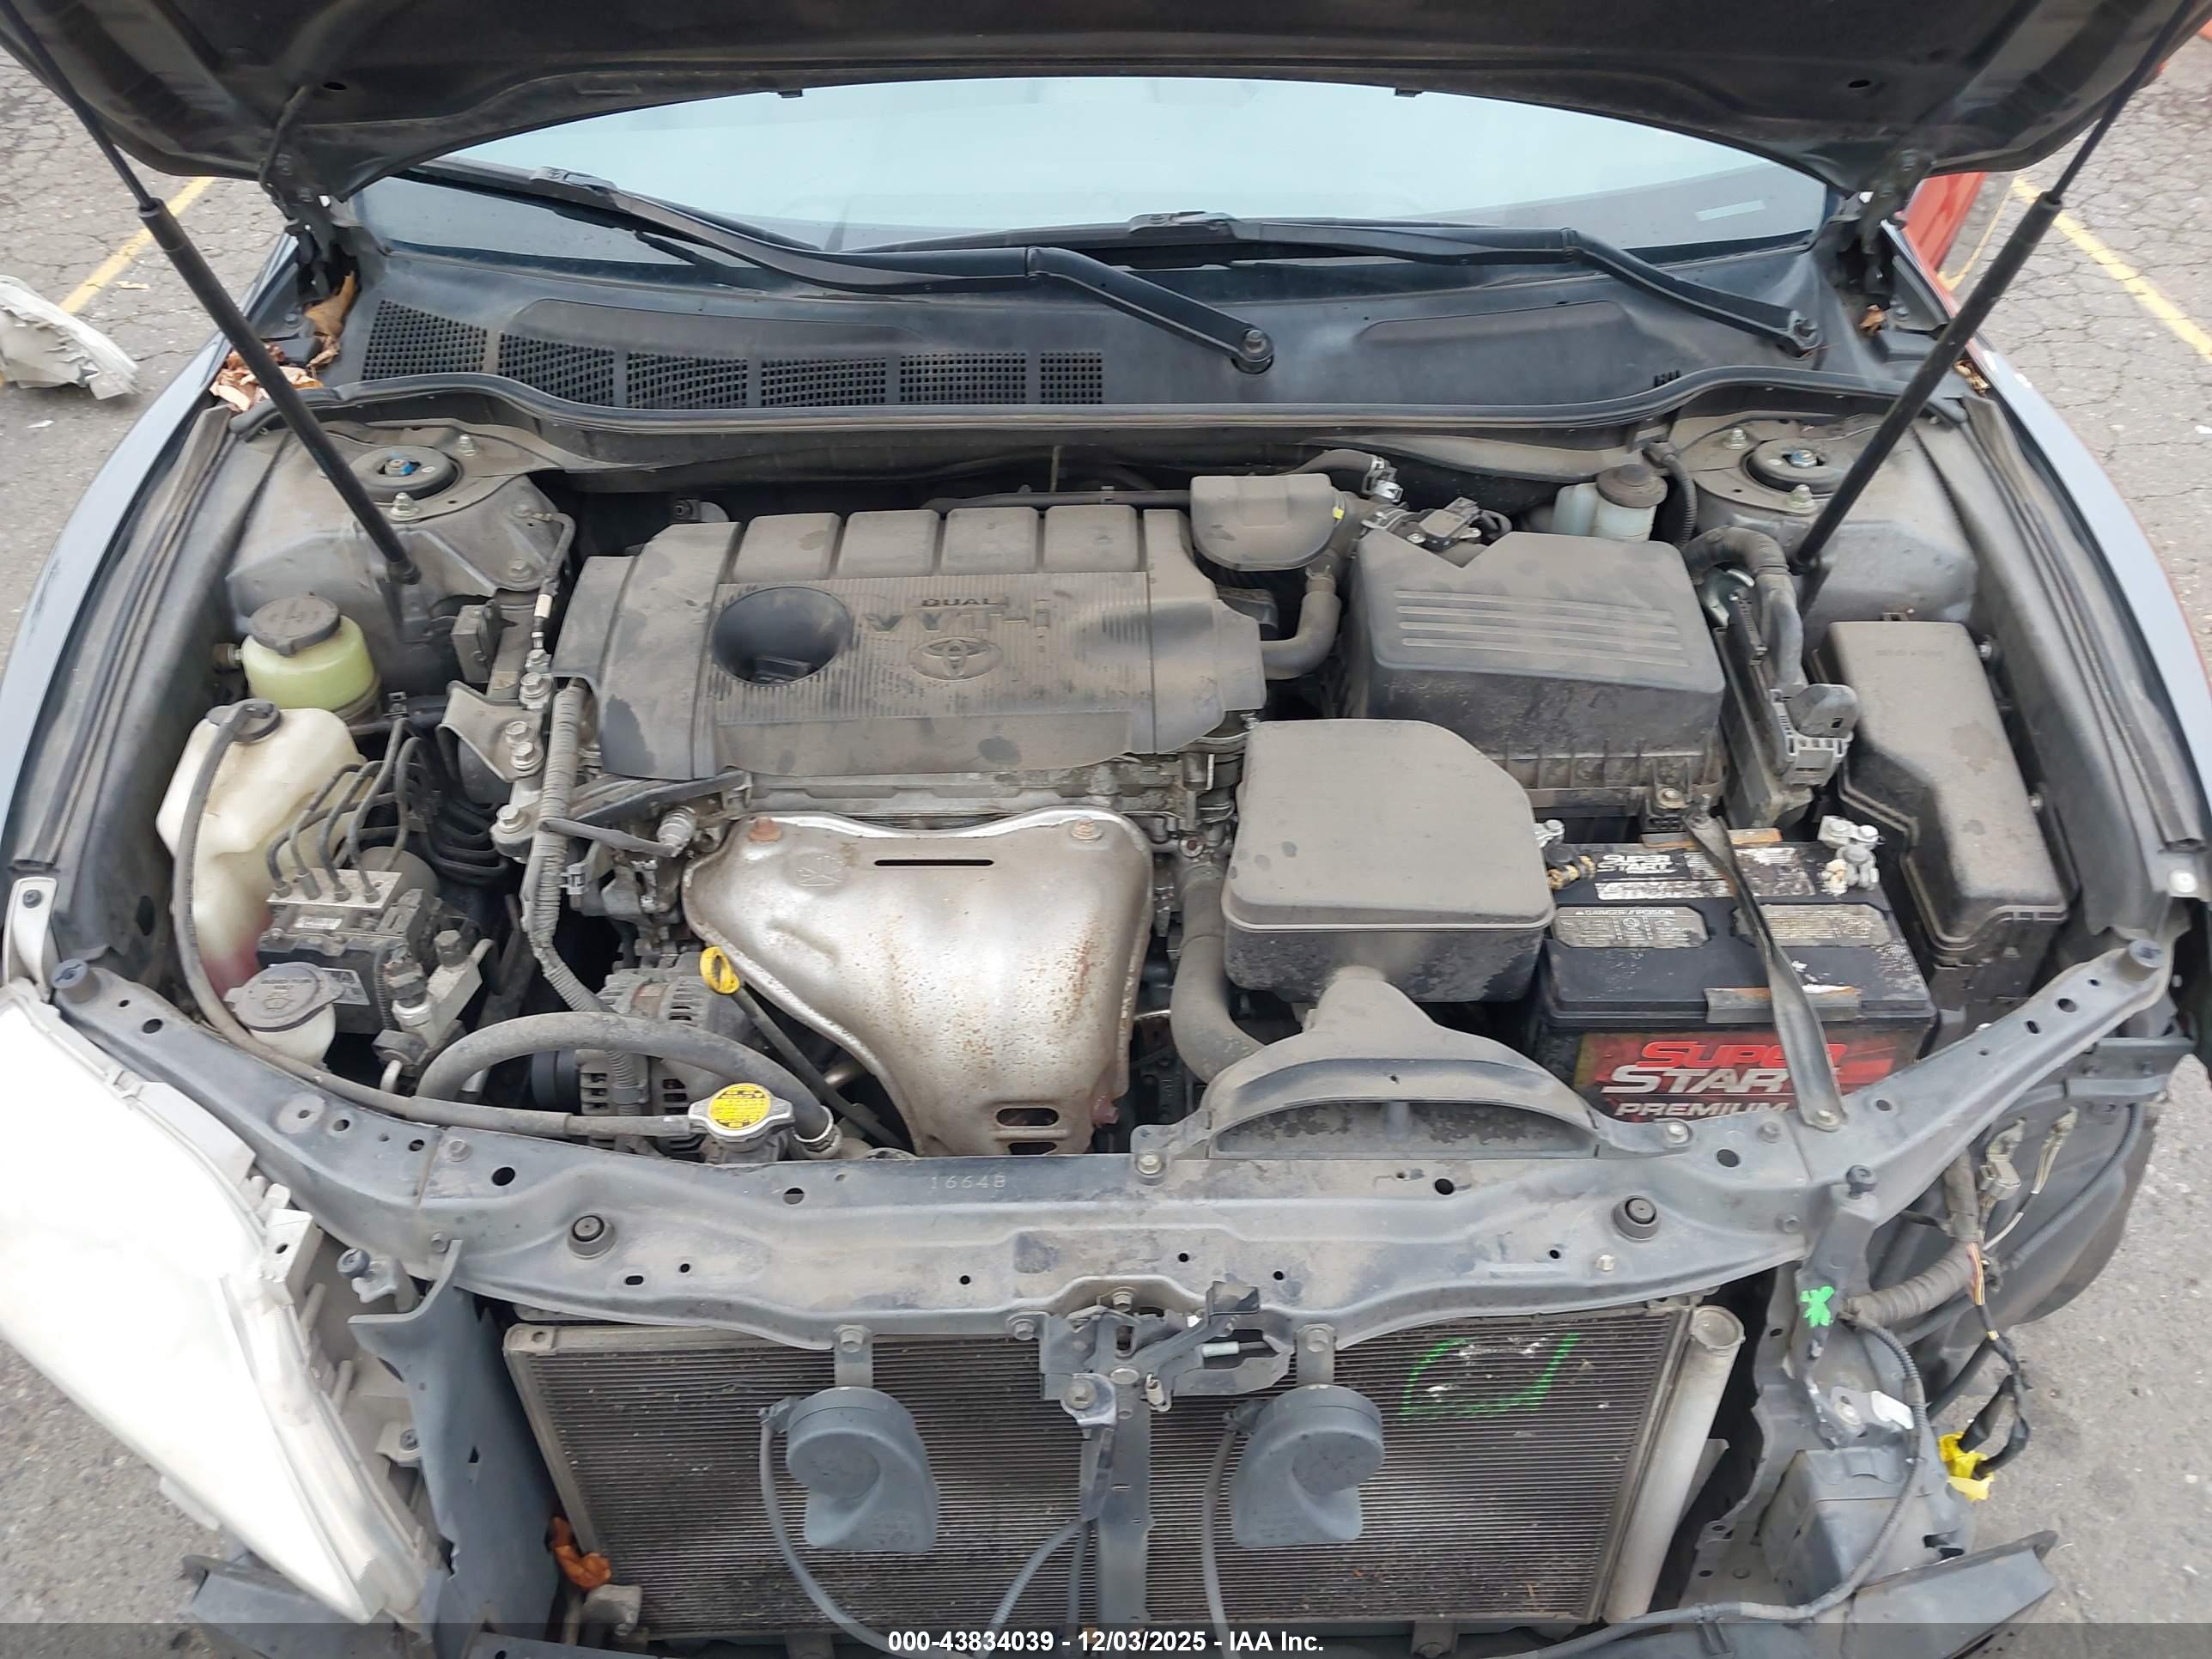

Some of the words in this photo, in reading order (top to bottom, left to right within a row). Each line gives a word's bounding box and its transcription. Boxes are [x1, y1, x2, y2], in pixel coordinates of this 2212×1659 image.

[921, 598, 1000, 606] DUAL
[1601, 1064, 1841, 1094] STAR
[1614, 1103, 1790, 1116] PREMIUM
